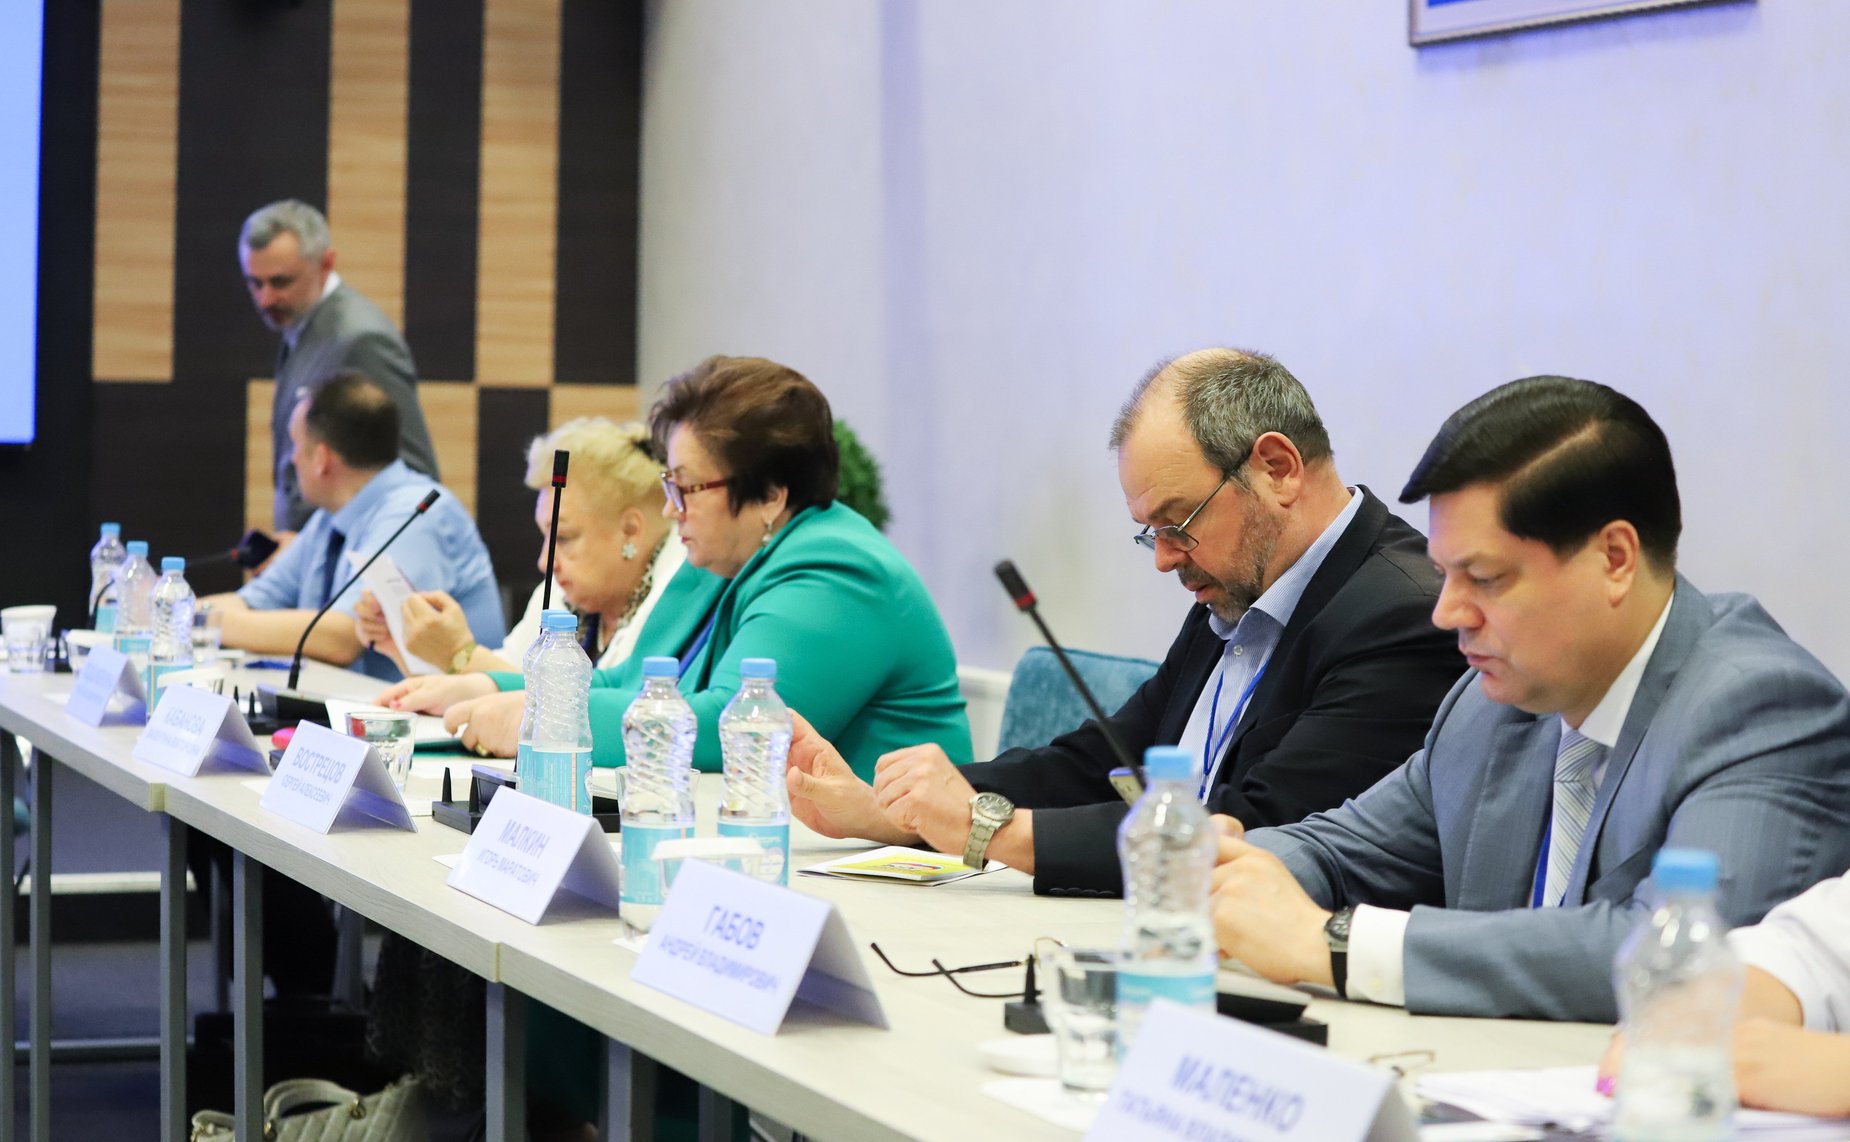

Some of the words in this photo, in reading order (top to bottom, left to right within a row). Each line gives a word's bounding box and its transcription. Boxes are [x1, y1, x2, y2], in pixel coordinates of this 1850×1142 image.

[292, 746, 347, 785] ВОСТРЕЦОВ
[497, 818, 552, 859] МАЛКИН
[702, 905, 766, 951] ГАБОВ
[1169, 1053, 1307, 1133] МАЛЕНКО
